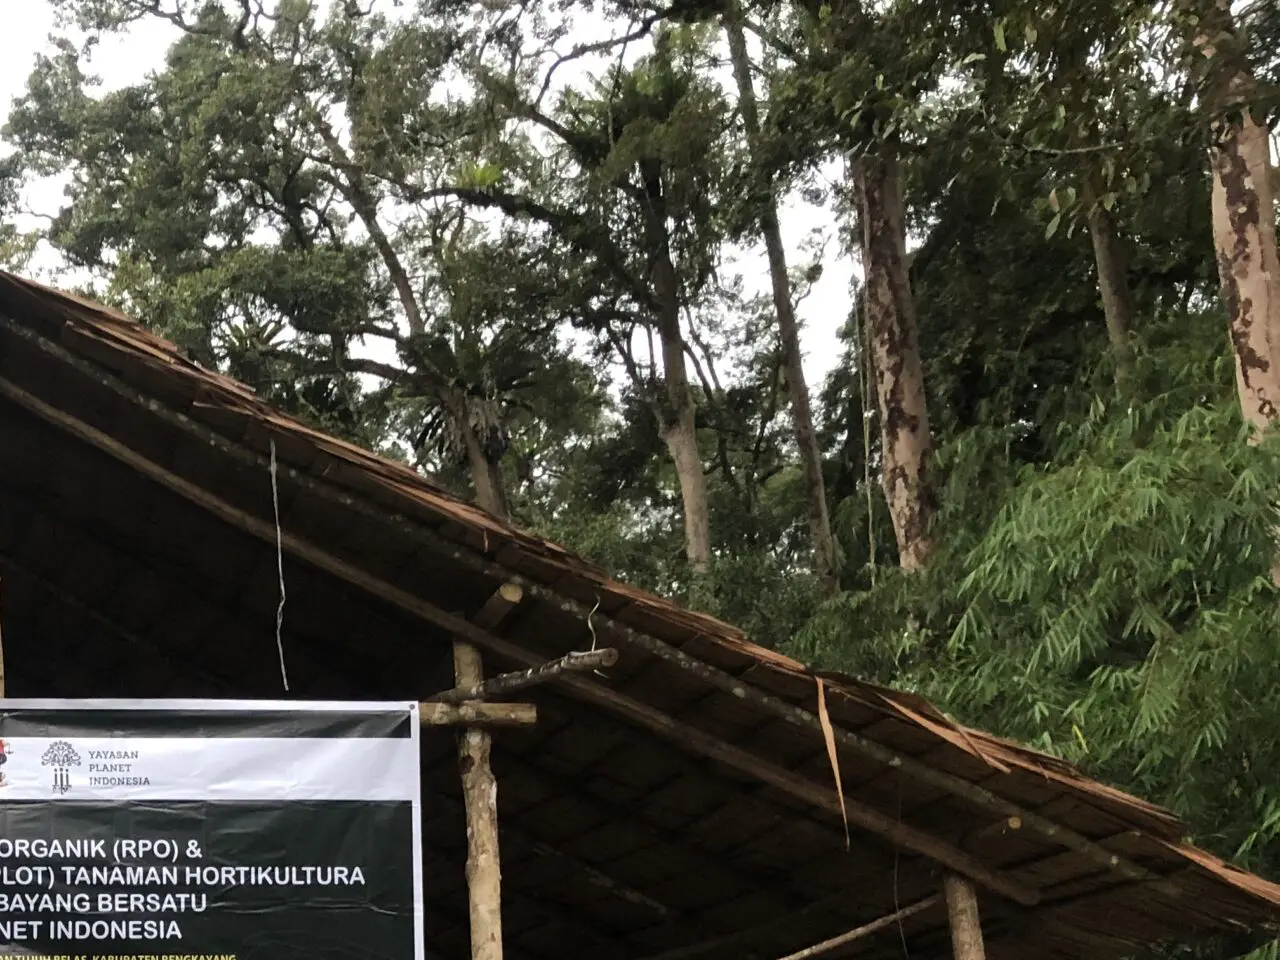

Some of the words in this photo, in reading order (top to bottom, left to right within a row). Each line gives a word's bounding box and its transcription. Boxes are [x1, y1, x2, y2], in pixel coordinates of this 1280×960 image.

[88, 751, 138, 759] YAYASAN
[89, 764, 132, 772] PLANET
[89, 777, 150, 785] INDONESIA
[113, 840, 178, 862] (RPO)
[186, 840, 202, 858] &
[62, 867, 178, 885] TANAMAN
[185, 867, 365, 885] HORTIKULTURA
[98, 893, 207, 911] BERSATU
[50, 921, 182, 939] INDONESIA
